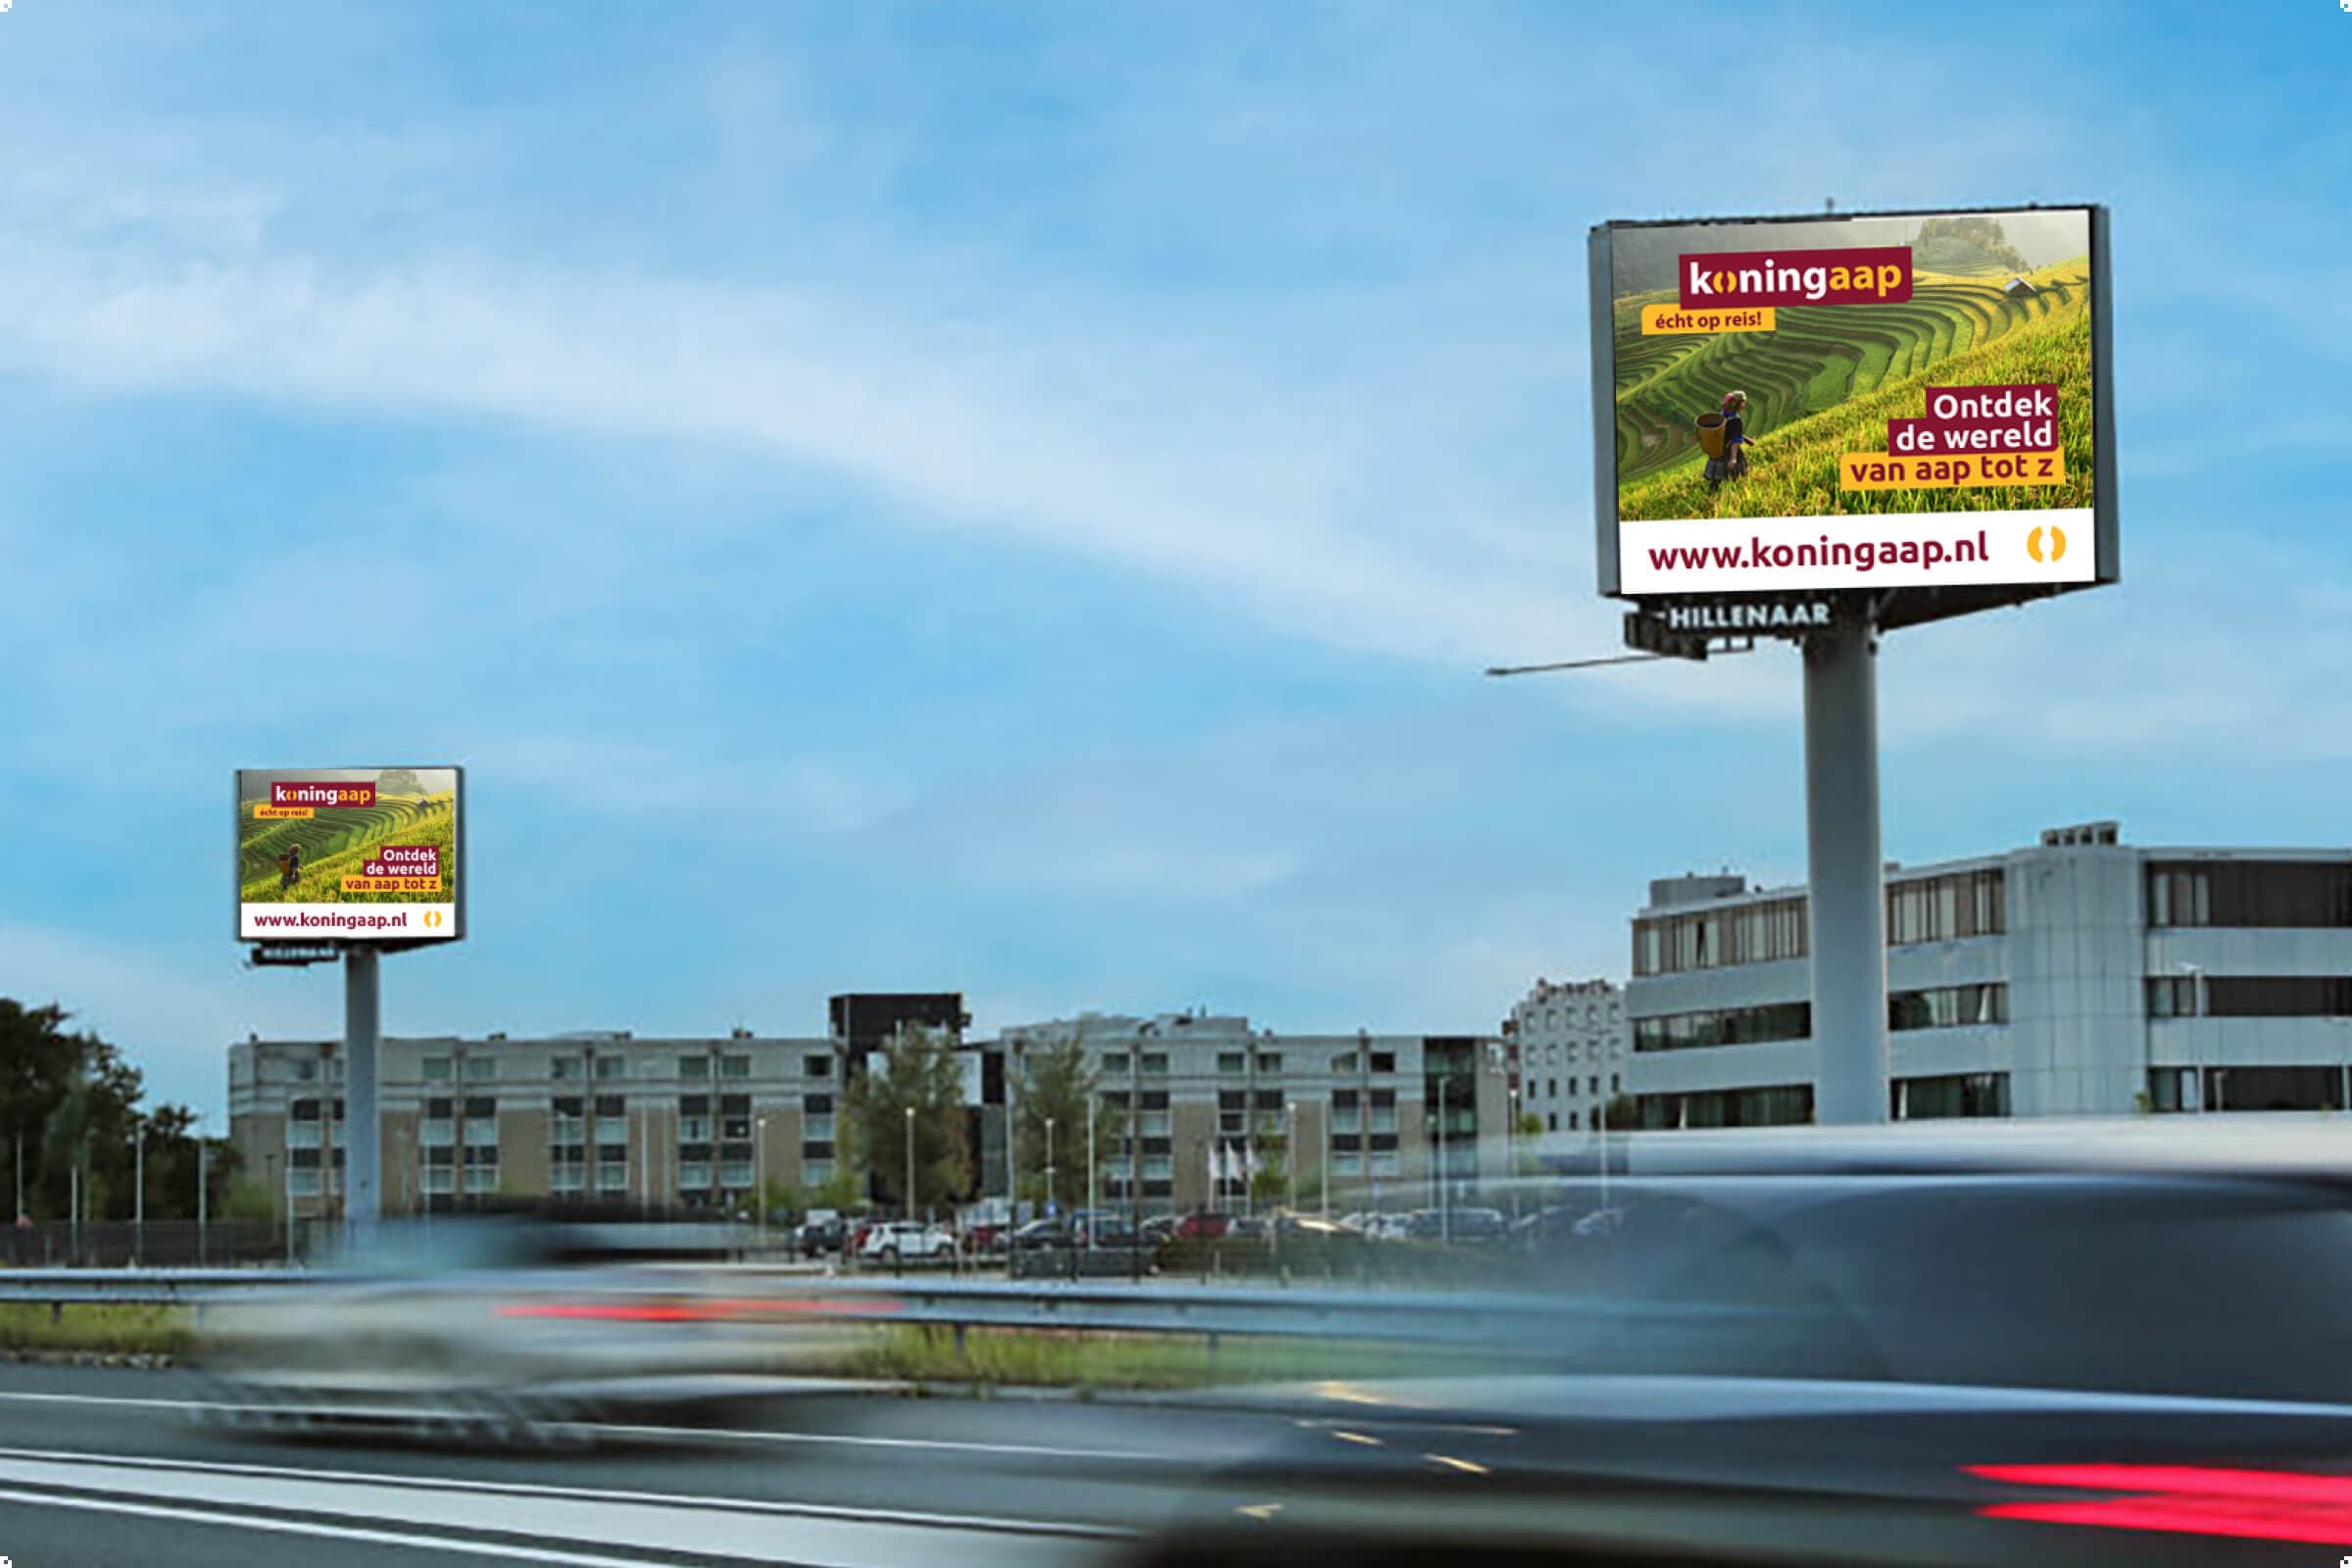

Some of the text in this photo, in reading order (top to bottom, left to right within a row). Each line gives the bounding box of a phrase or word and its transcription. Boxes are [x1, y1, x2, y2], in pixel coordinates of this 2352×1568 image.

[1690, 259, 1902, 299] koningaap
[1654, 311, 1762, 332] écht op reis!
[1933, 391, 2052, 419] Ontdek
[1895, 421, 2052, 450] de wereld
[1850, 455, 2053, 485] van aap tot z
[1648, 531, 1989, 571] www.koningaap.nl
[1670, 603, 1831, 628] HILLENAAR
[275, 786, 370, 804] koningaap
[384, 849, 436, 861] Ontdek
[367, 862, 436, 875] de wereld
[346, 878, 436, 891] van aap tot z
[255, 912, 407, 929] www.koningaap.nl
